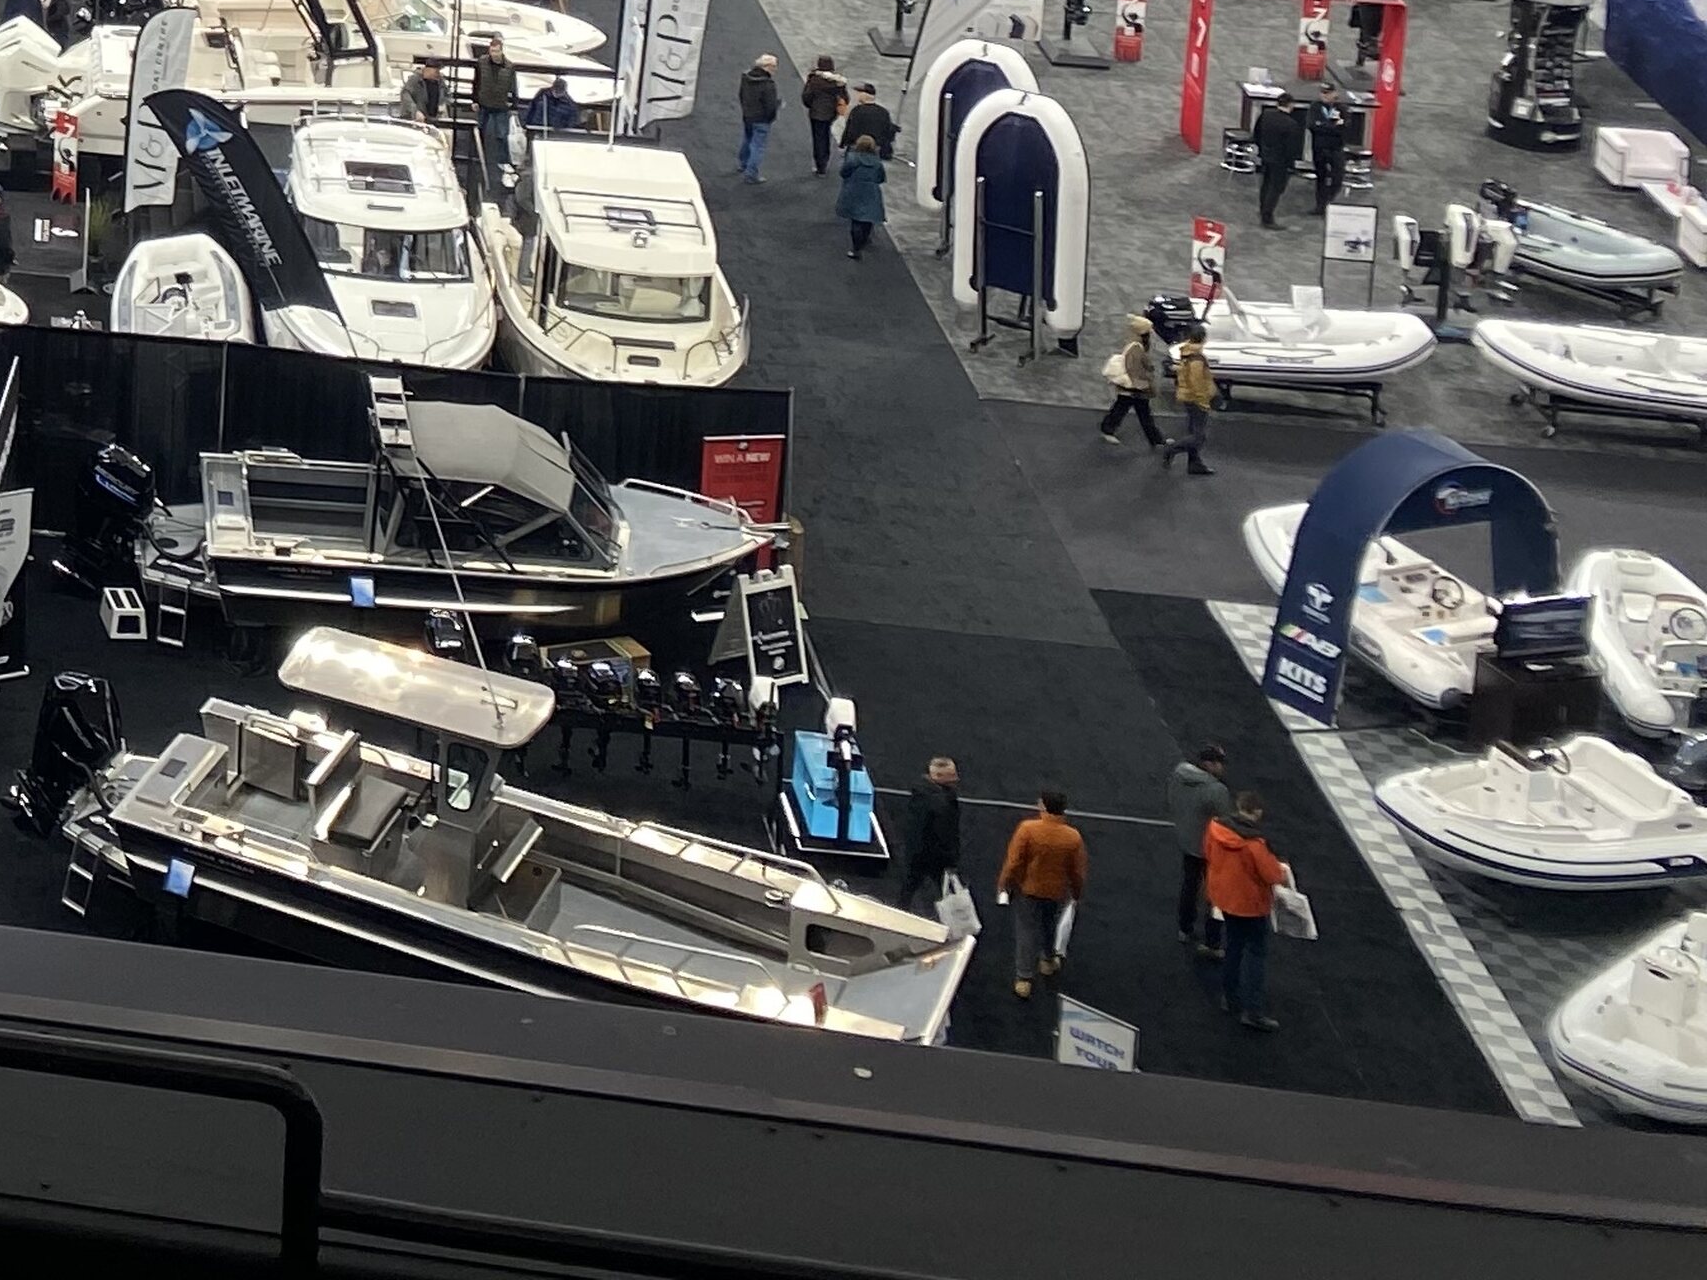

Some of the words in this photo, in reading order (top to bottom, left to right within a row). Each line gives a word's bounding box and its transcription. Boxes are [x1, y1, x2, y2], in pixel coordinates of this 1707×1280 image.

[646, 13, 694, 107] M&P
[207, 147, 283, 267] INLETMARINE
[714, 452, 735, 464] WIN
[745, 451, 771, 463] NEW
[1277, 655, 1327, 694] KITS
[1069, 1026, 1126, 1060] WATCH
